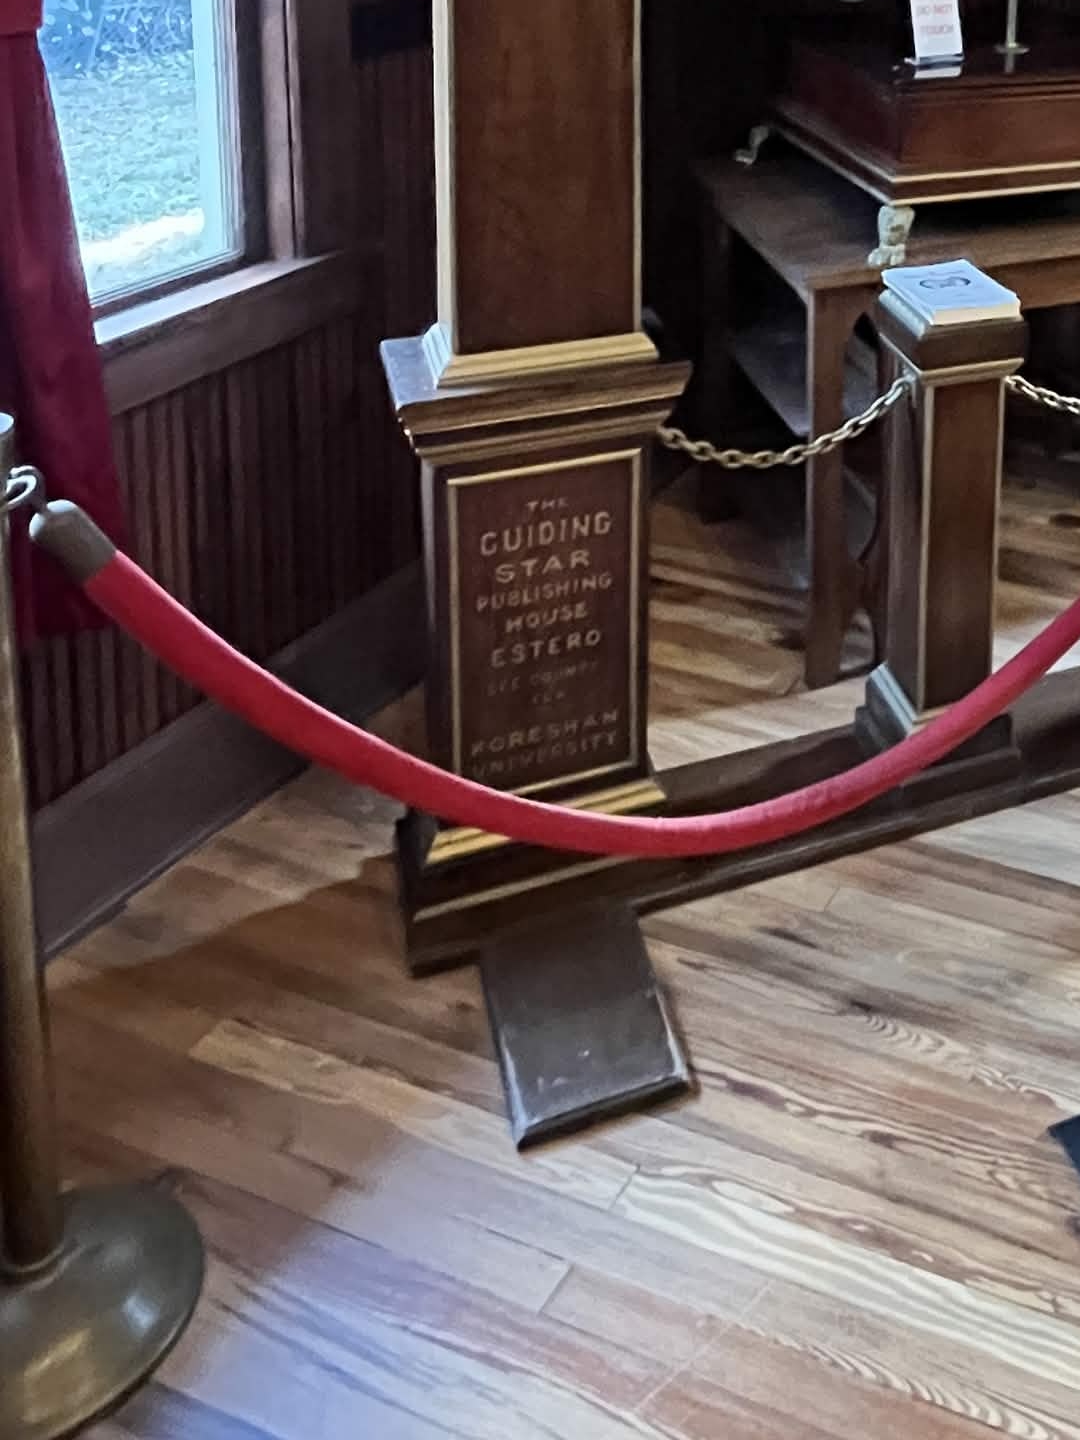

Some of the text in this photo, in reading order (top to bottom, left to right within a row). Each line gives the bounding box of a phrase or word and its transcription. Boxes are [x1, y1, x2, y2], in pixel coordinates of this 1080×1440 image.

[526, 497, 568, 511] THE
[480, 511, 612, 556] GUIDING
[496, 549, 590, 584] STAR
[476, 572, 612, 612] PUBLISHING
[505, 602, 588, 633] HOUSE
[491, 629, 601, 668] ESTERO
[471, 710, 618, 756] KORESHAN
[471, 730, 617, 777] UNIVERSITY
